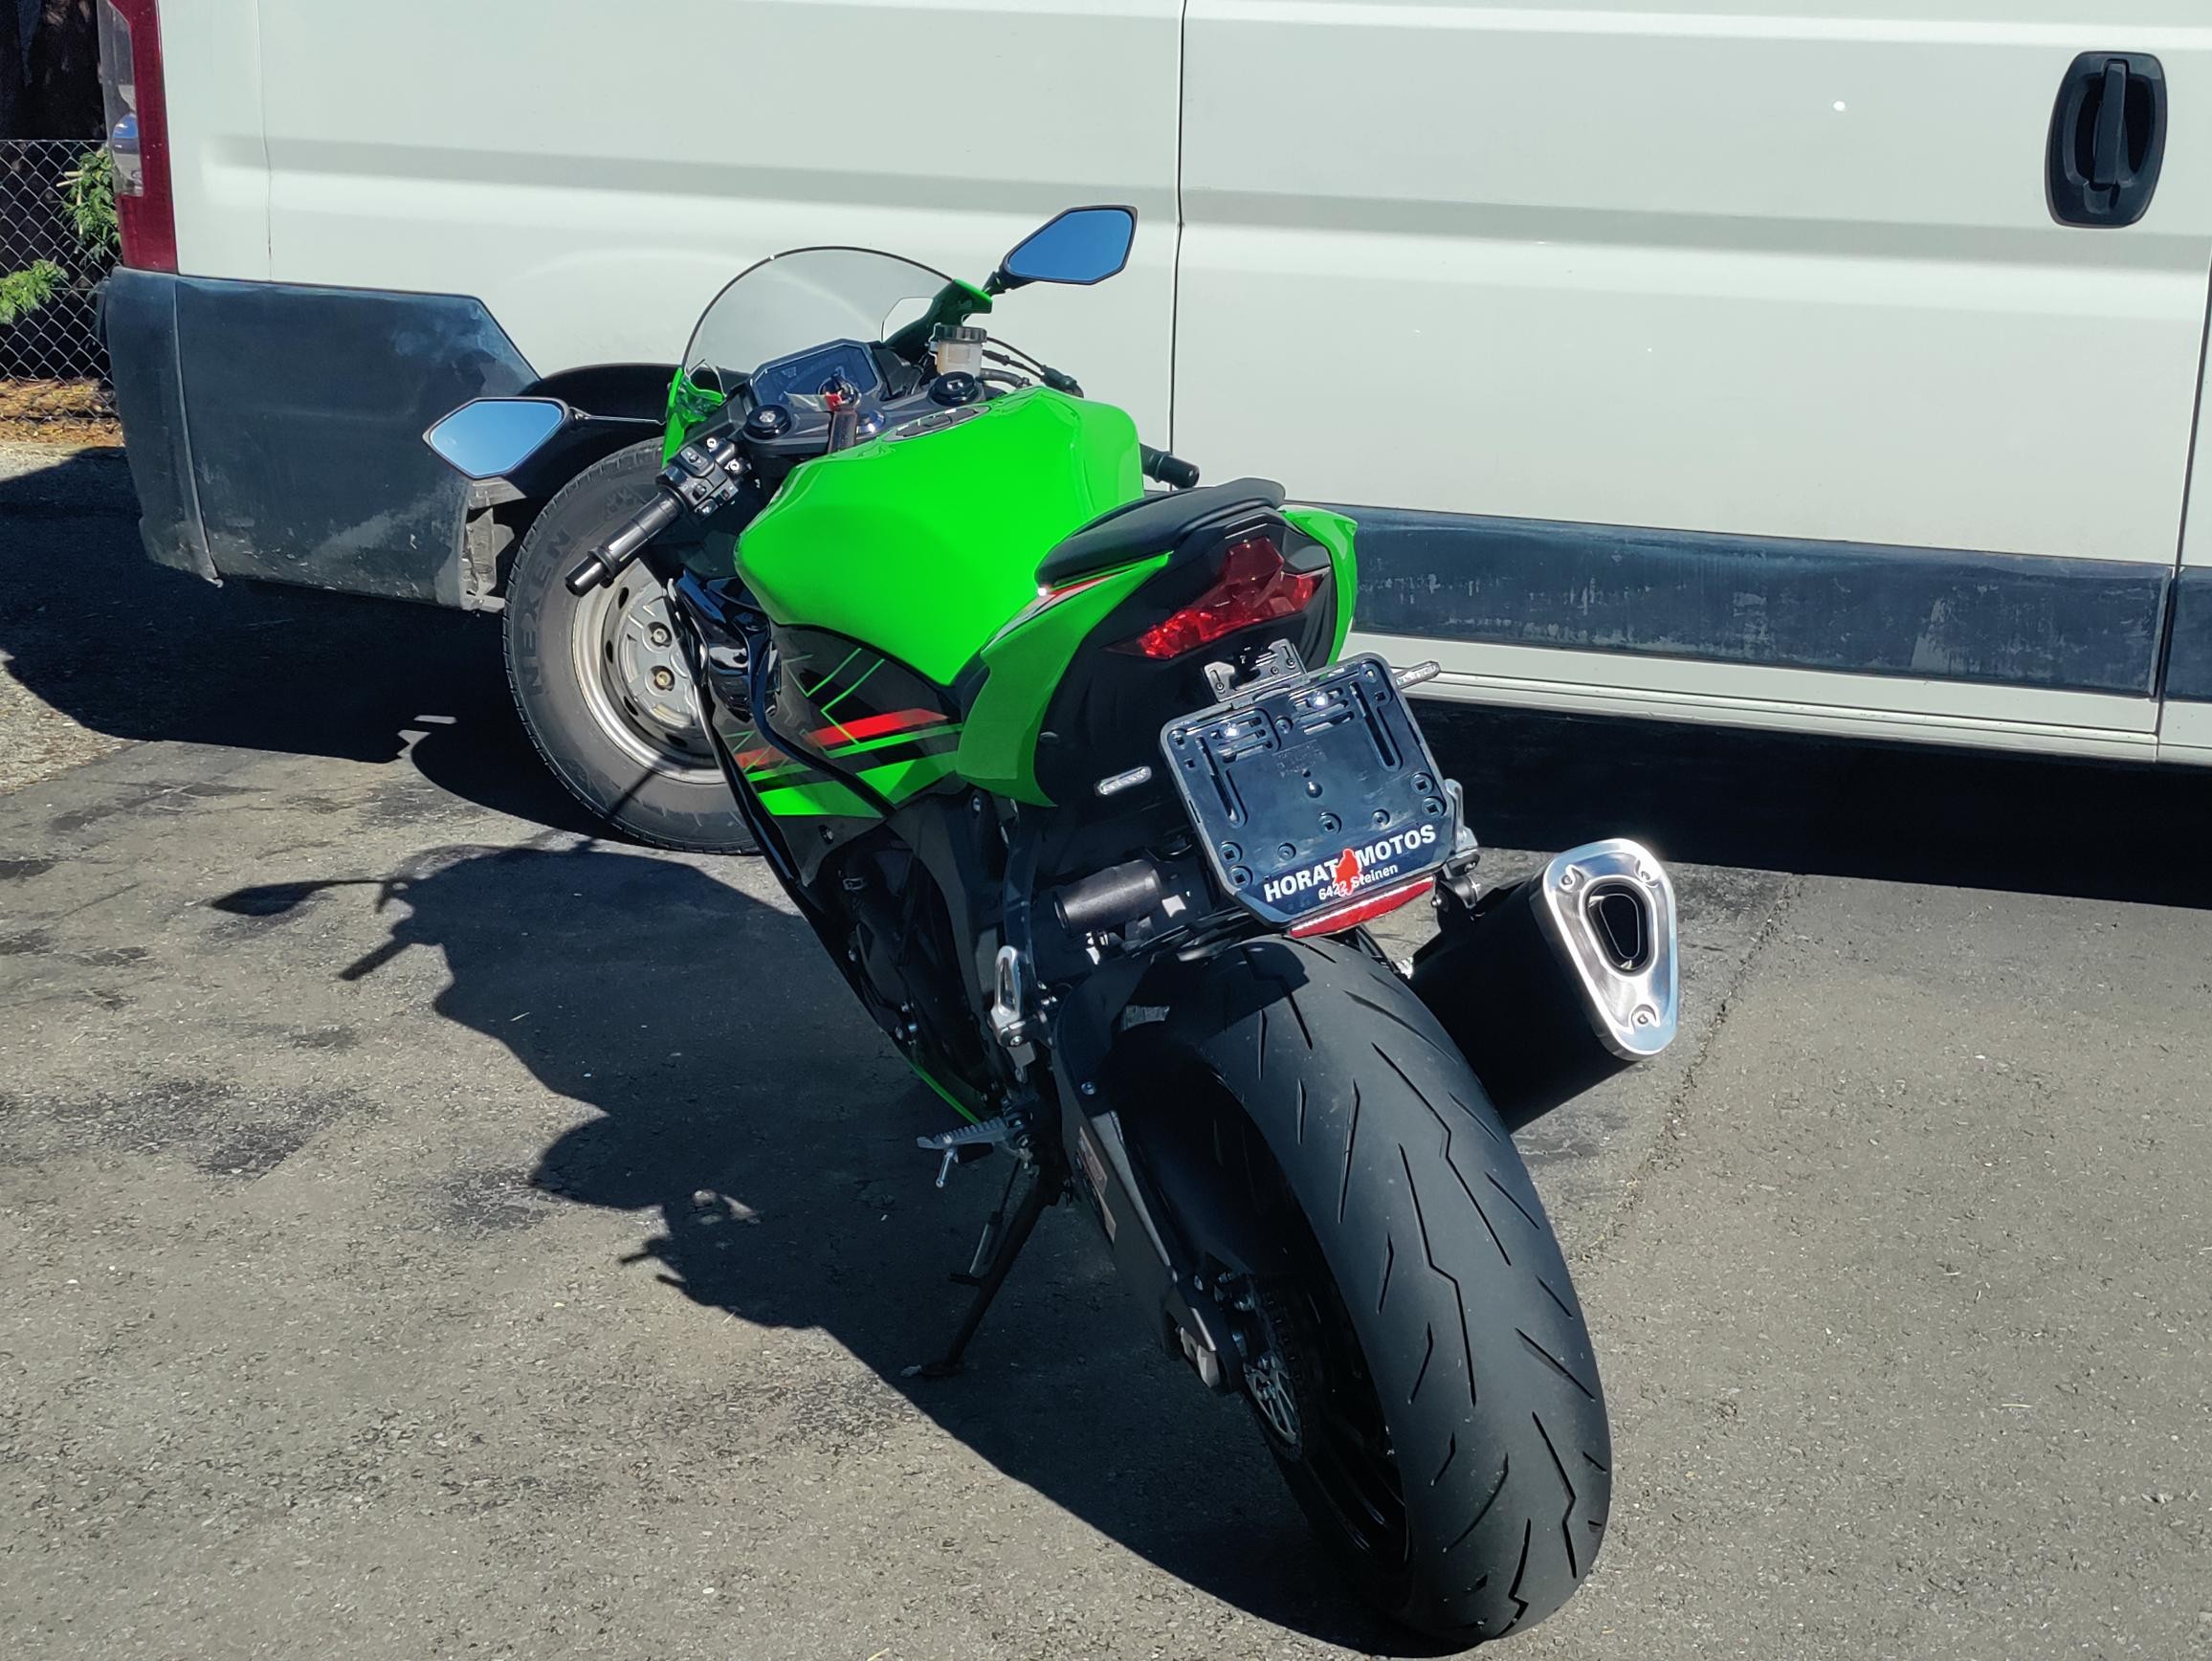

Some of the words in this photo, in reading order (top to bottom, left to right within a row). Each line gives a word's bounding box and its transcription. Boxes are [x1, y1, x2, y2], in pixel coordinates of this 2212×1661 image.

[521, 528, 572, 698] NEXEN
[1355, 824, 1436, 867] MOTOS
[1318, 881, 1348, 900] 6422
[1350, 864, 1399, 888] Steinen
